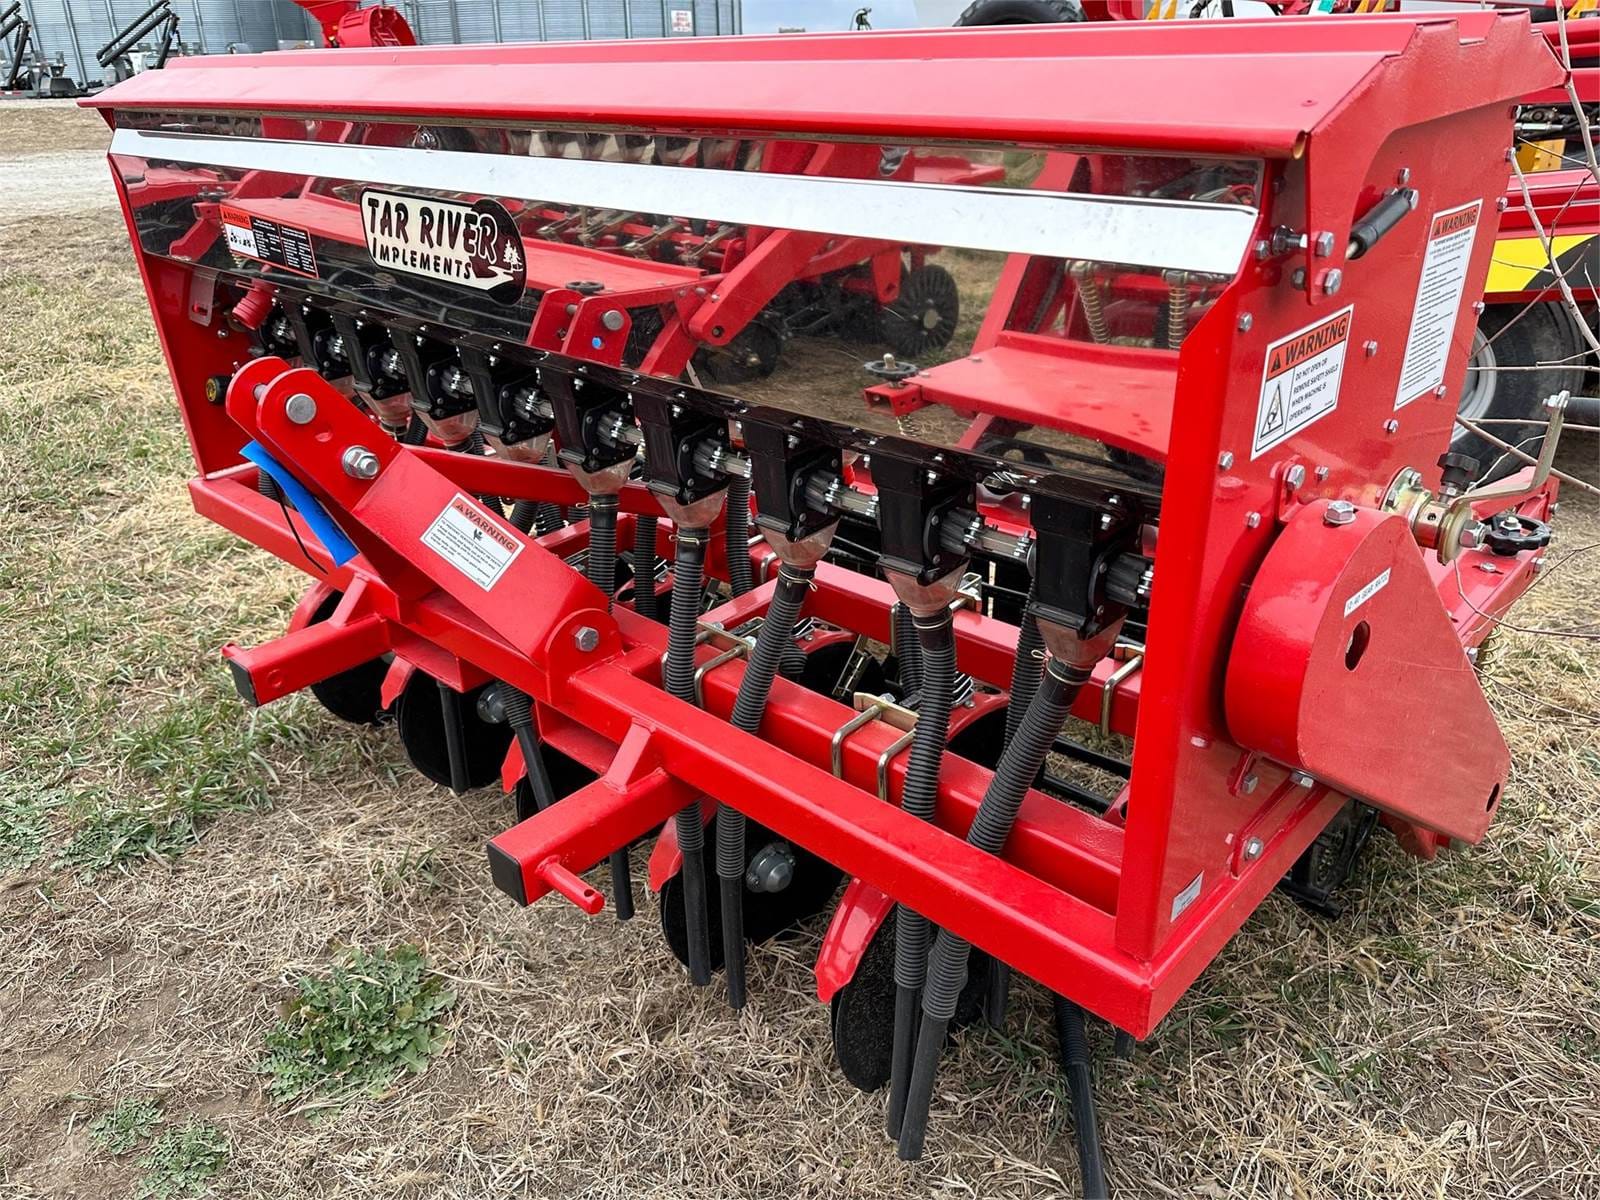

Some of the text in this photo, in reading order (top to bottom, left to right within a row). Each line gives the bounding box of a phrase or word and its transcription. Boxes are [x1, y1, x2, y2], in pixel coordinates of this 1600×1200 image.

[368, 198, 498, 265] TAR RIVER
[1442, 206, 1477, 233] WARNING
[373, 238, 473, 280] IMPLEMENTS
[1285, 317, 1347, 365] WARNING
[464, 508, 515, 551] WARNING
